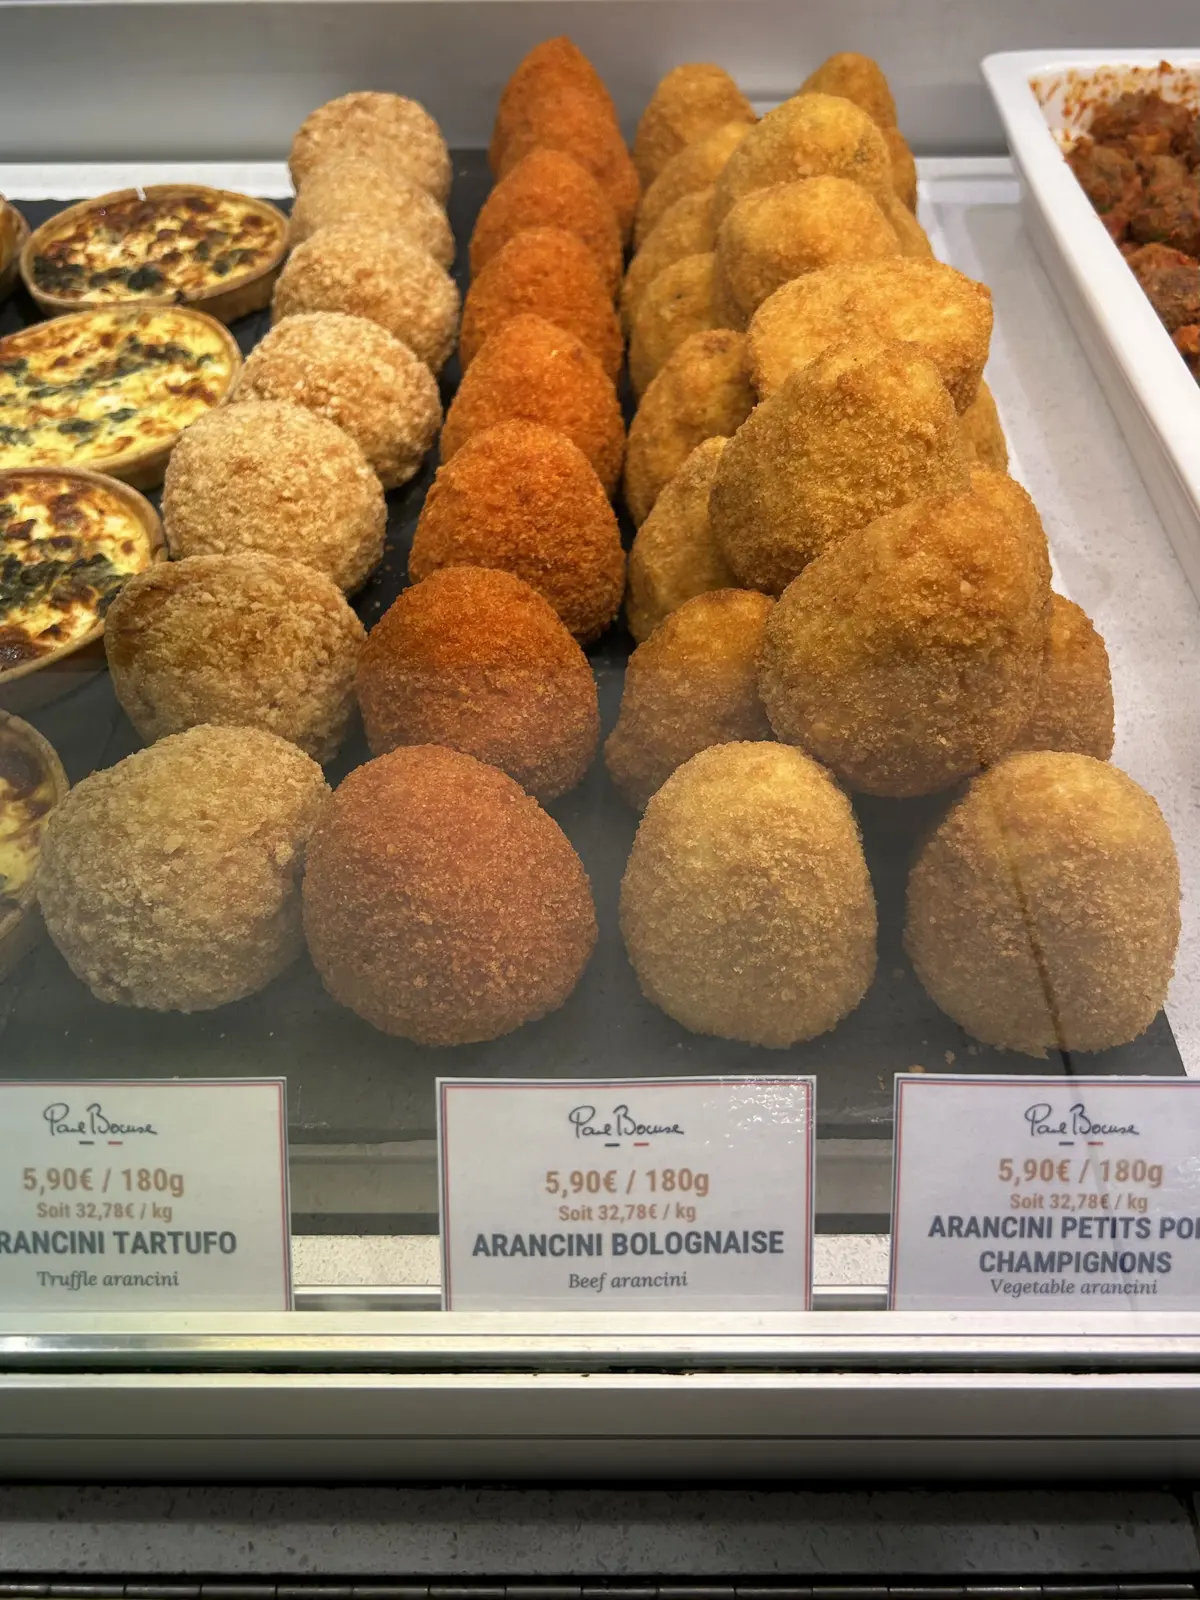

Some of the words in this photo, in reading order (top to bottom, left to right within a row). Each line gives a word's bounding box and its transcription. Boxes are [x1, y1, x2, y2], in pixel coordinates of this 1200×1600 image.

[87, 1103, 158, 1135] Bocuse
[613, 1105, 684, 1136] Bocuse
[1069, 1103, 1140, 1136] Bocuse
[22, 1167, 94, 1196] 5,90€
[101, 1168, 111, 1193] /
[121, 1168, 185, 1197] 180g
[546, 1170, 617, 1198] 5,90€
[626, 1170, 636, 1194] /
[646, 1168, 709, 1196] 180g
[998, 1158, 1071, 1186] 5,90€
[1078, 1158, 1089, 1184] /
[1100, 1159, 1163, 1187] 180g
[37, 1203, 71, 1219] Soit
[76, 1203, 134, 1221] 32,78€
[140, 1203, 147, 1219] /
[152, 1203, 173, 1223] kg
[559, 1206, 593, 1222] Soit
[598, 1204, 656, 1223] 32,78€
[662, 1204, 670, 1220] /
[676, 1203, 696, 1222] kg
[1010, 1193, 1044, 1210] Soit
[1049, 1193, 1109, 1212] 32,78€
[1114, 1194, 1121, 1210] /
[1127, 1194, 1148, 1213] kg
[928, 1215, 1052, 1238] ARANCINI
[1061, 1216, 1151, 1239] PETITS
[1159, 1216, 1200, 1239] POI
[0, 1231, 105, 1254] RANCINI
[113, 1231, 237, 1254] TARTUFO
[472, 1233, 602, 1257] ARANCINI
[612, 1230, 784, 1256] BOLOGNAISE
[979, 1250, 1172, 1273] CHAMPIGNONS
[37, 1270, 98, 1291] Truffle
[103, 1270, 179, 1287] arancini
[569, 1273, 606, 1293] Beef
[611, 1272, 688, 1288] arancini
[991, 1278, 1075, 1298] Vegetable
[1080, 1280, 1158, 1294] arancini
